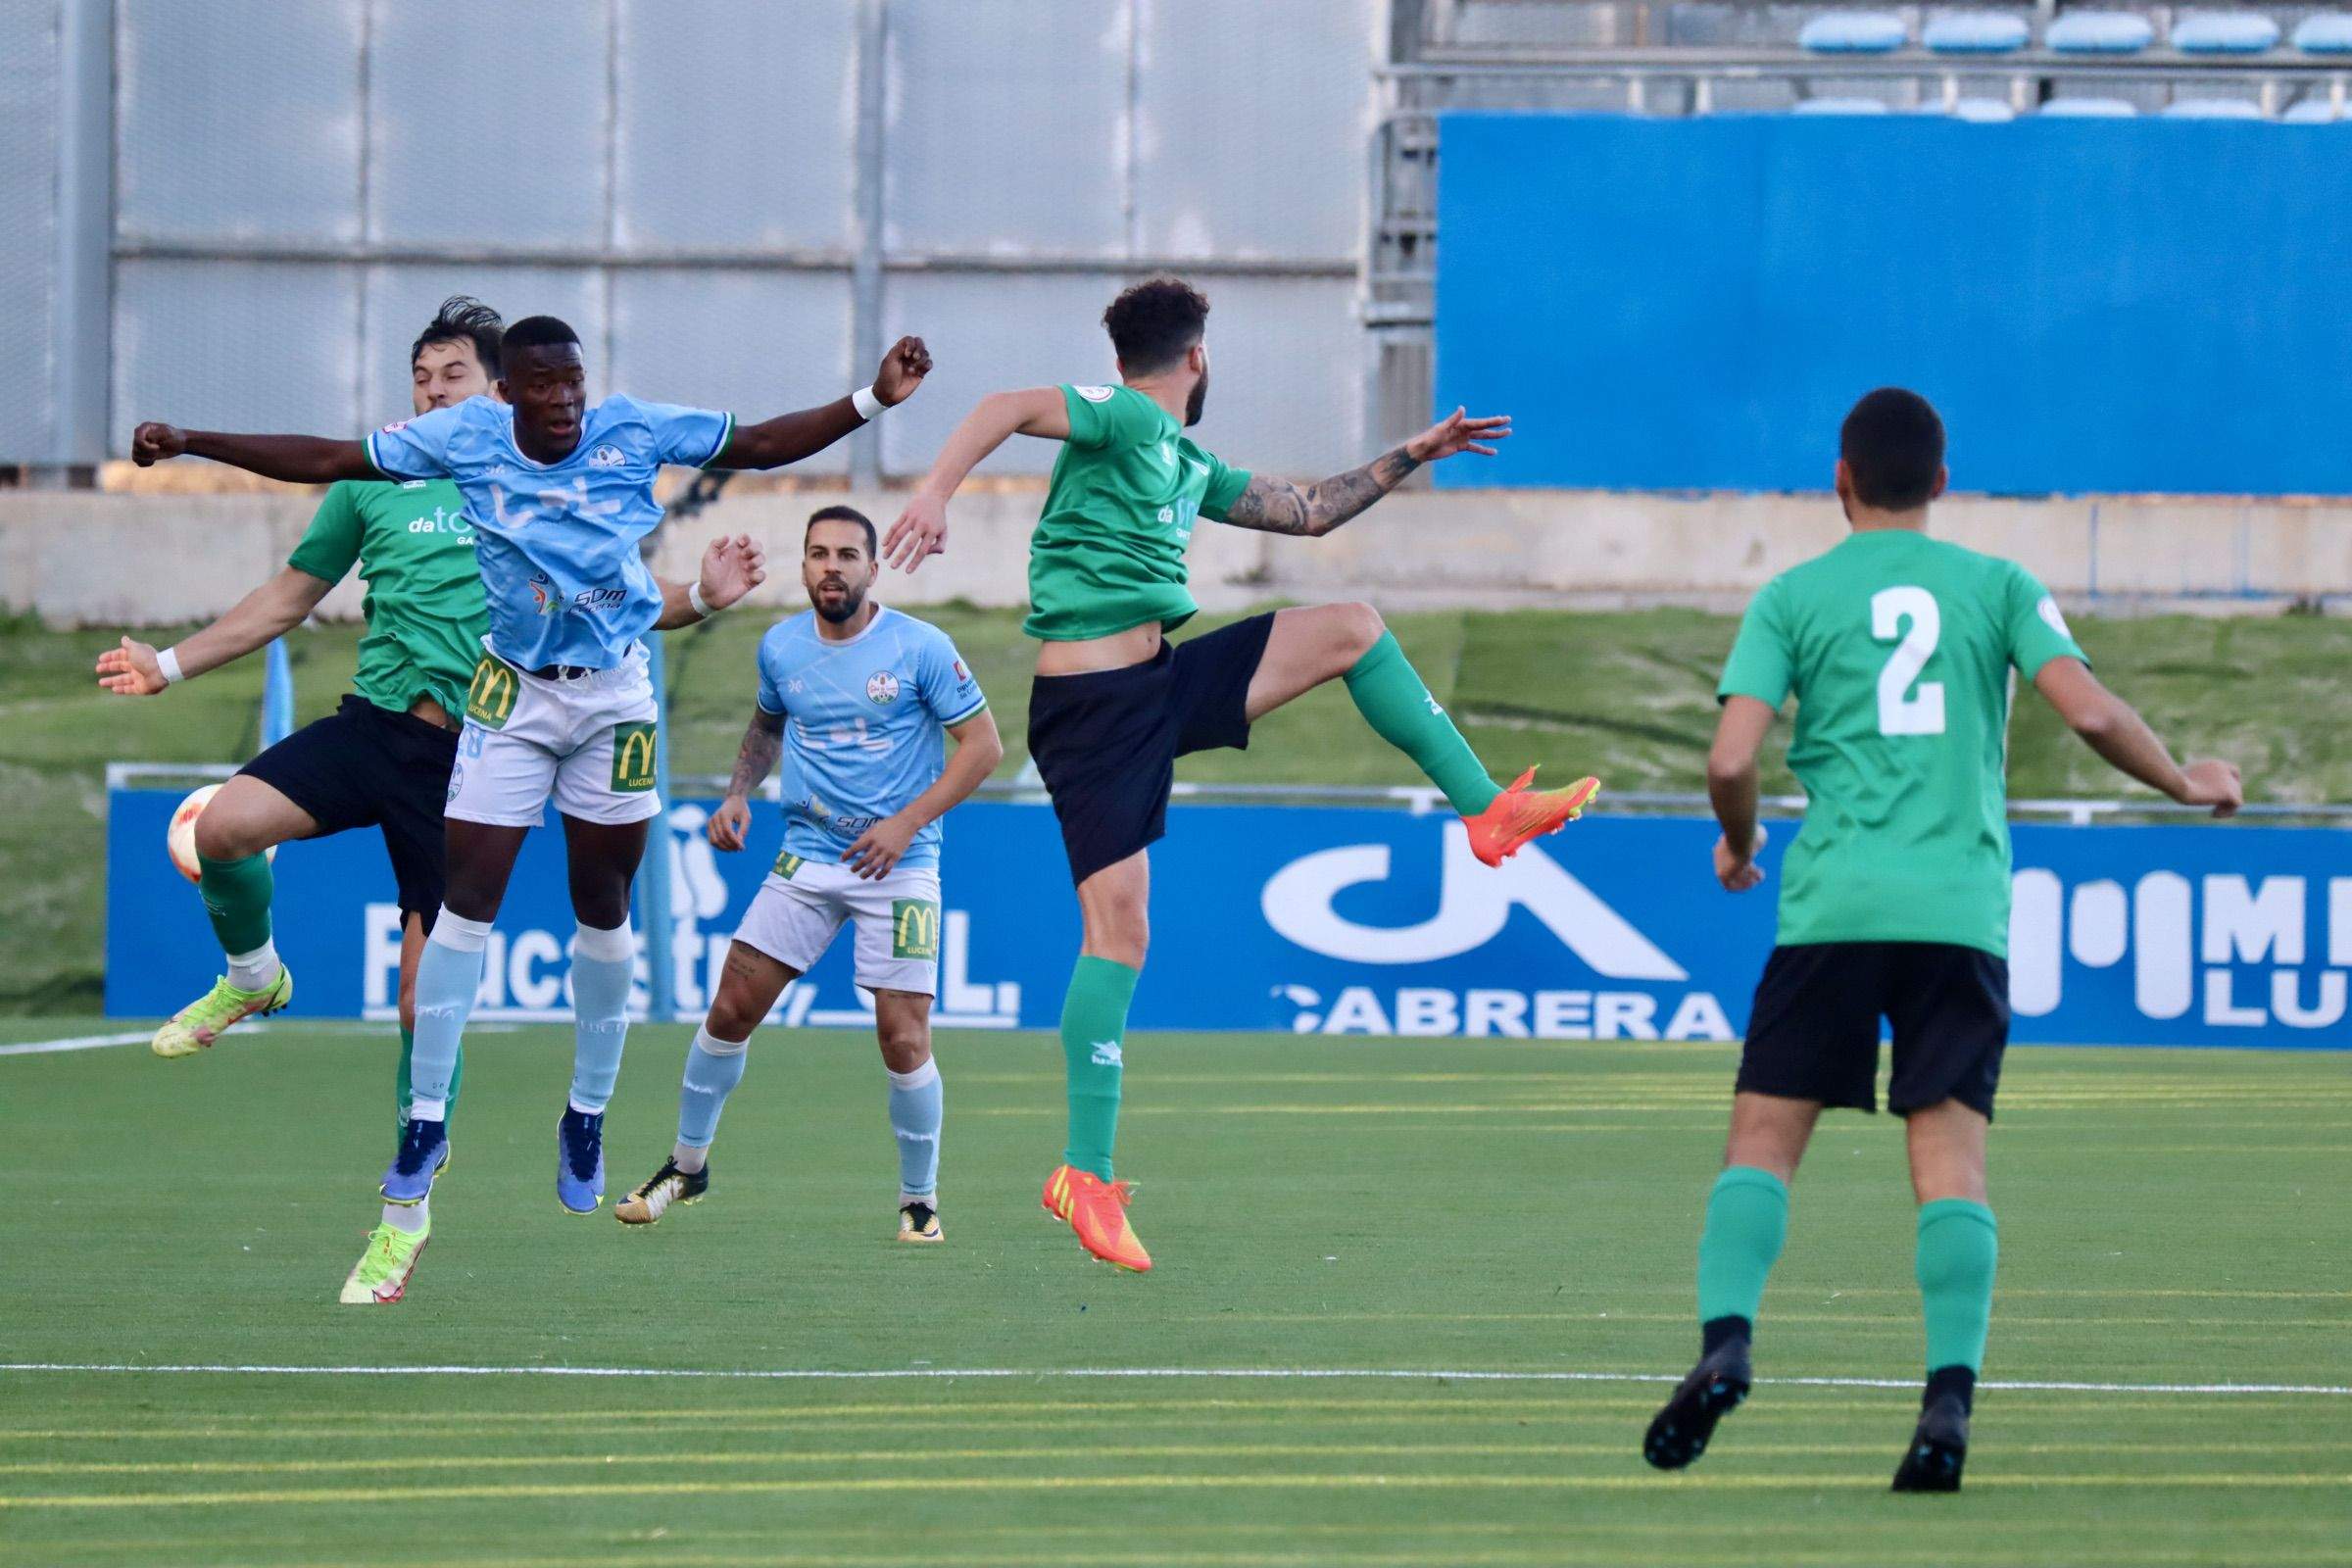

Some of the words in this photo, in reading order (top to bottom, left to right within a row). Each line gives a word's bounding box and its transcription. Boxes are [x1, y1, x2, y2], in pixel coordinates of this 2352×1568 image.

[1871, 585, 1945, 736] 2
[467, 704, 493, 722] LUCENA
[628, 777, 655, 787] LUCEN
[906, 946, 934, 956] LUCE
[2204, 967, 2347, 1029] LU
